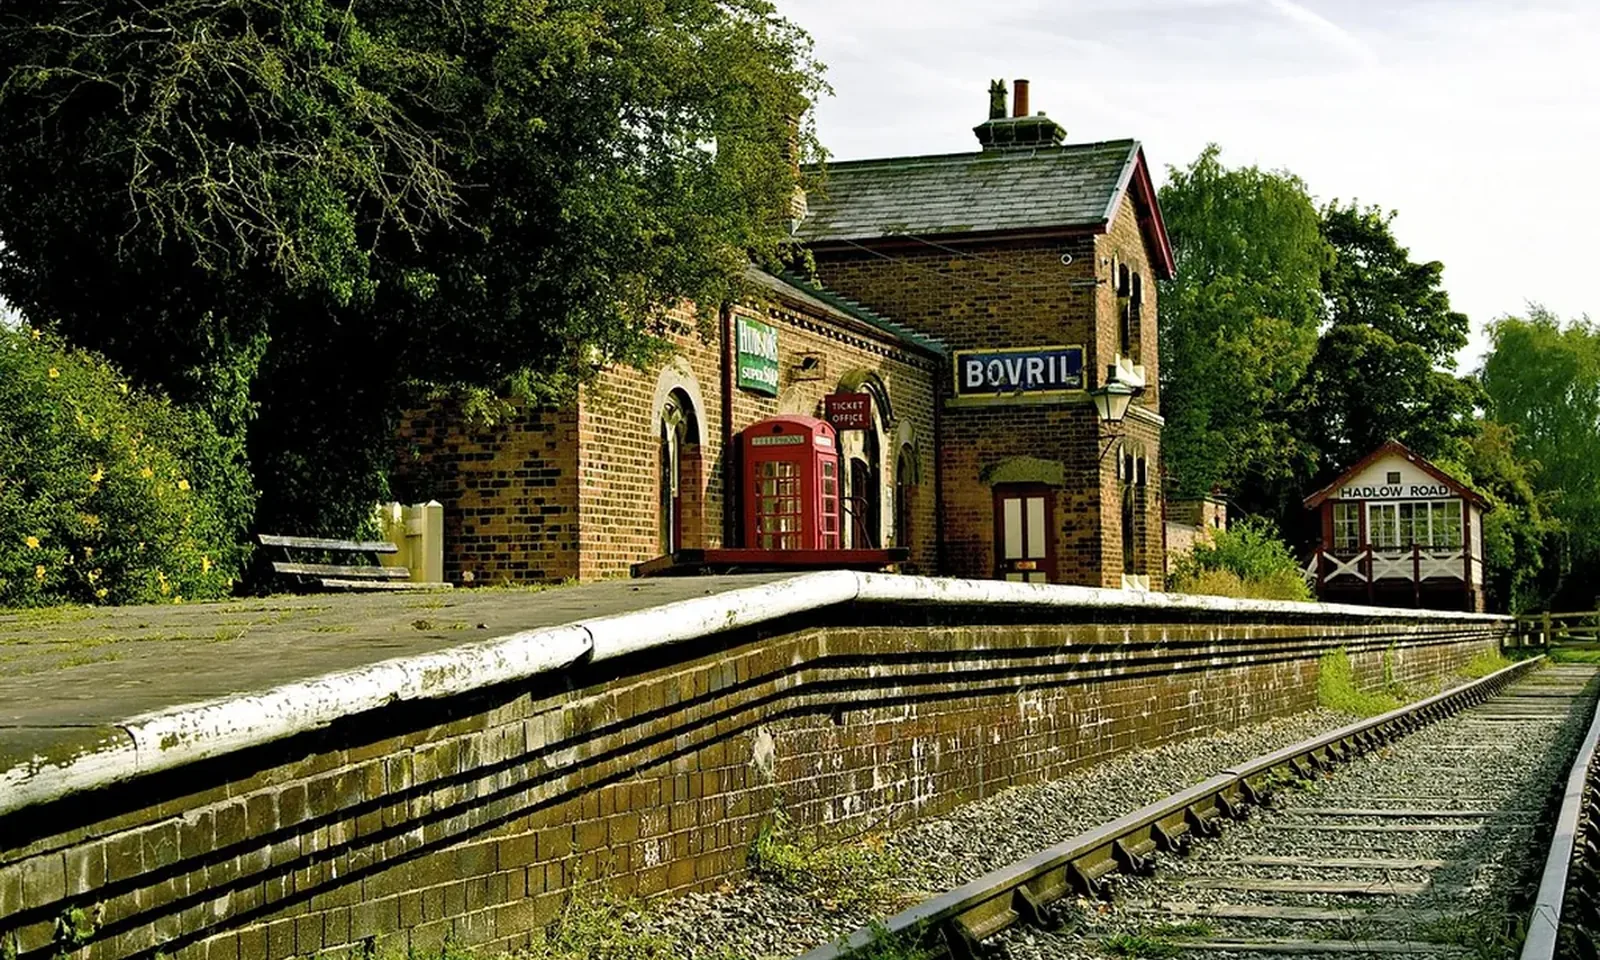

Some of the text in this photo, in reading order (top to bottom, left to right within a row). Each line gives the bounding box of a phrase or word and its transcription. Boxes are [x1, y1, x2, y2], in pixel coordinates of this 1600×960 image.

[966, 356, 1074, 388] BOVRIL
[832, 401, 864, 410] TICKET
[832, 413, 863, 422] OFFICE
[1341, 485, 1449, 498] HADLOW ROAD
